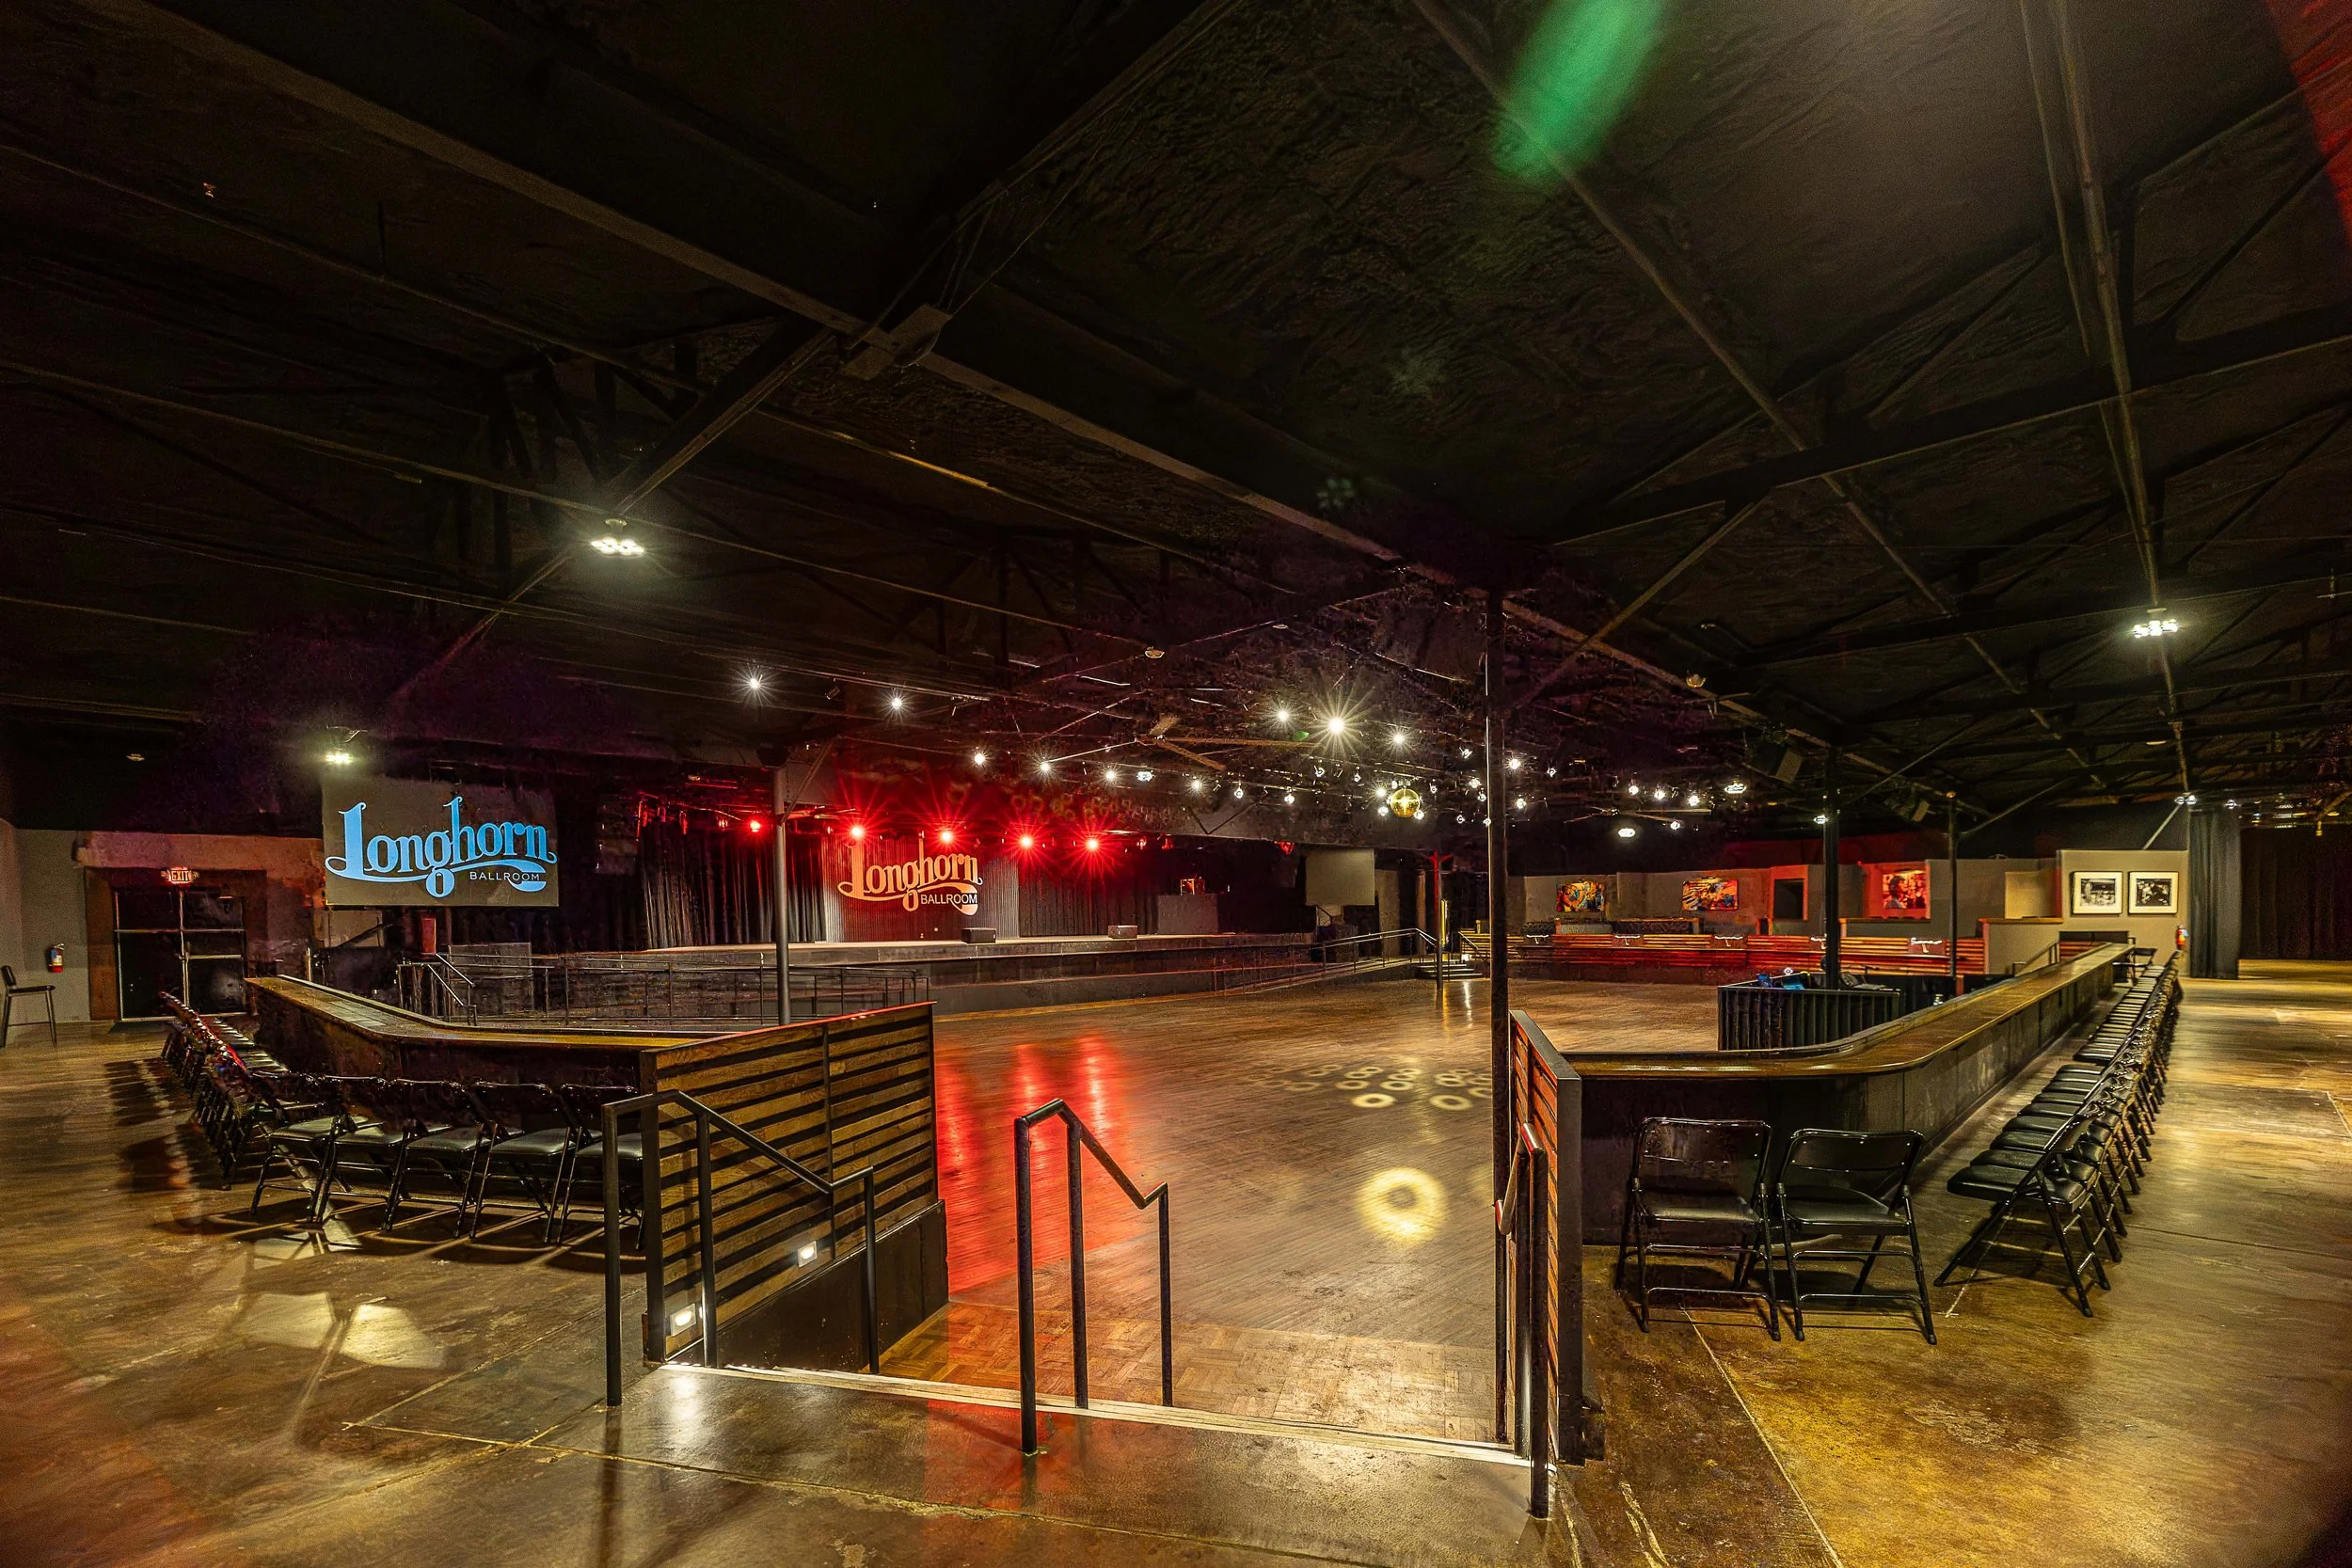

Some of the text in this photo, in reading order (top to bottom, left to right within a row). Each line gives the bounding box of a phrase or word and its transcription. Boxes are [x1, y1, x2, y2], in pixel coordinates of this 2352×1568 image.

[325, 796, 558, 898] Longhorn
[172, 870, 188, 880] EXIT
[469, 871, 540, 881] BALLROOM
[837, 838, 983, 912] Longhorn
[921, 895, 977, 905] BALLROOM
